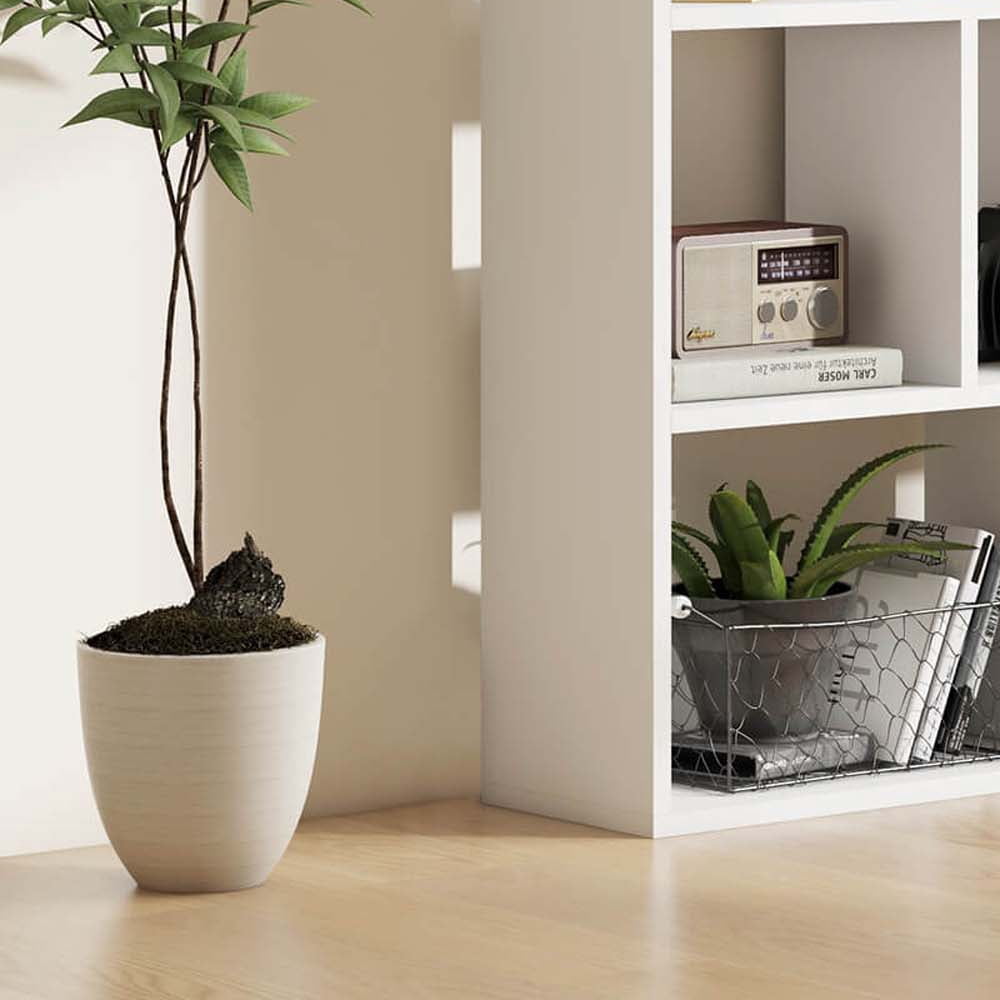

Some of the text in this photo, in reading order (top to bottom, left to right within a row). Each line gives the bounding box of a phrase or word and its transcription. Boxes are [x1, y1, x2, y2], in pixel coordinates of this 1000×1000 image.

[750, 356, 877, 376] Architektur für eine neue Zeit
[817, 368, 877, 382] CARL MOSER
